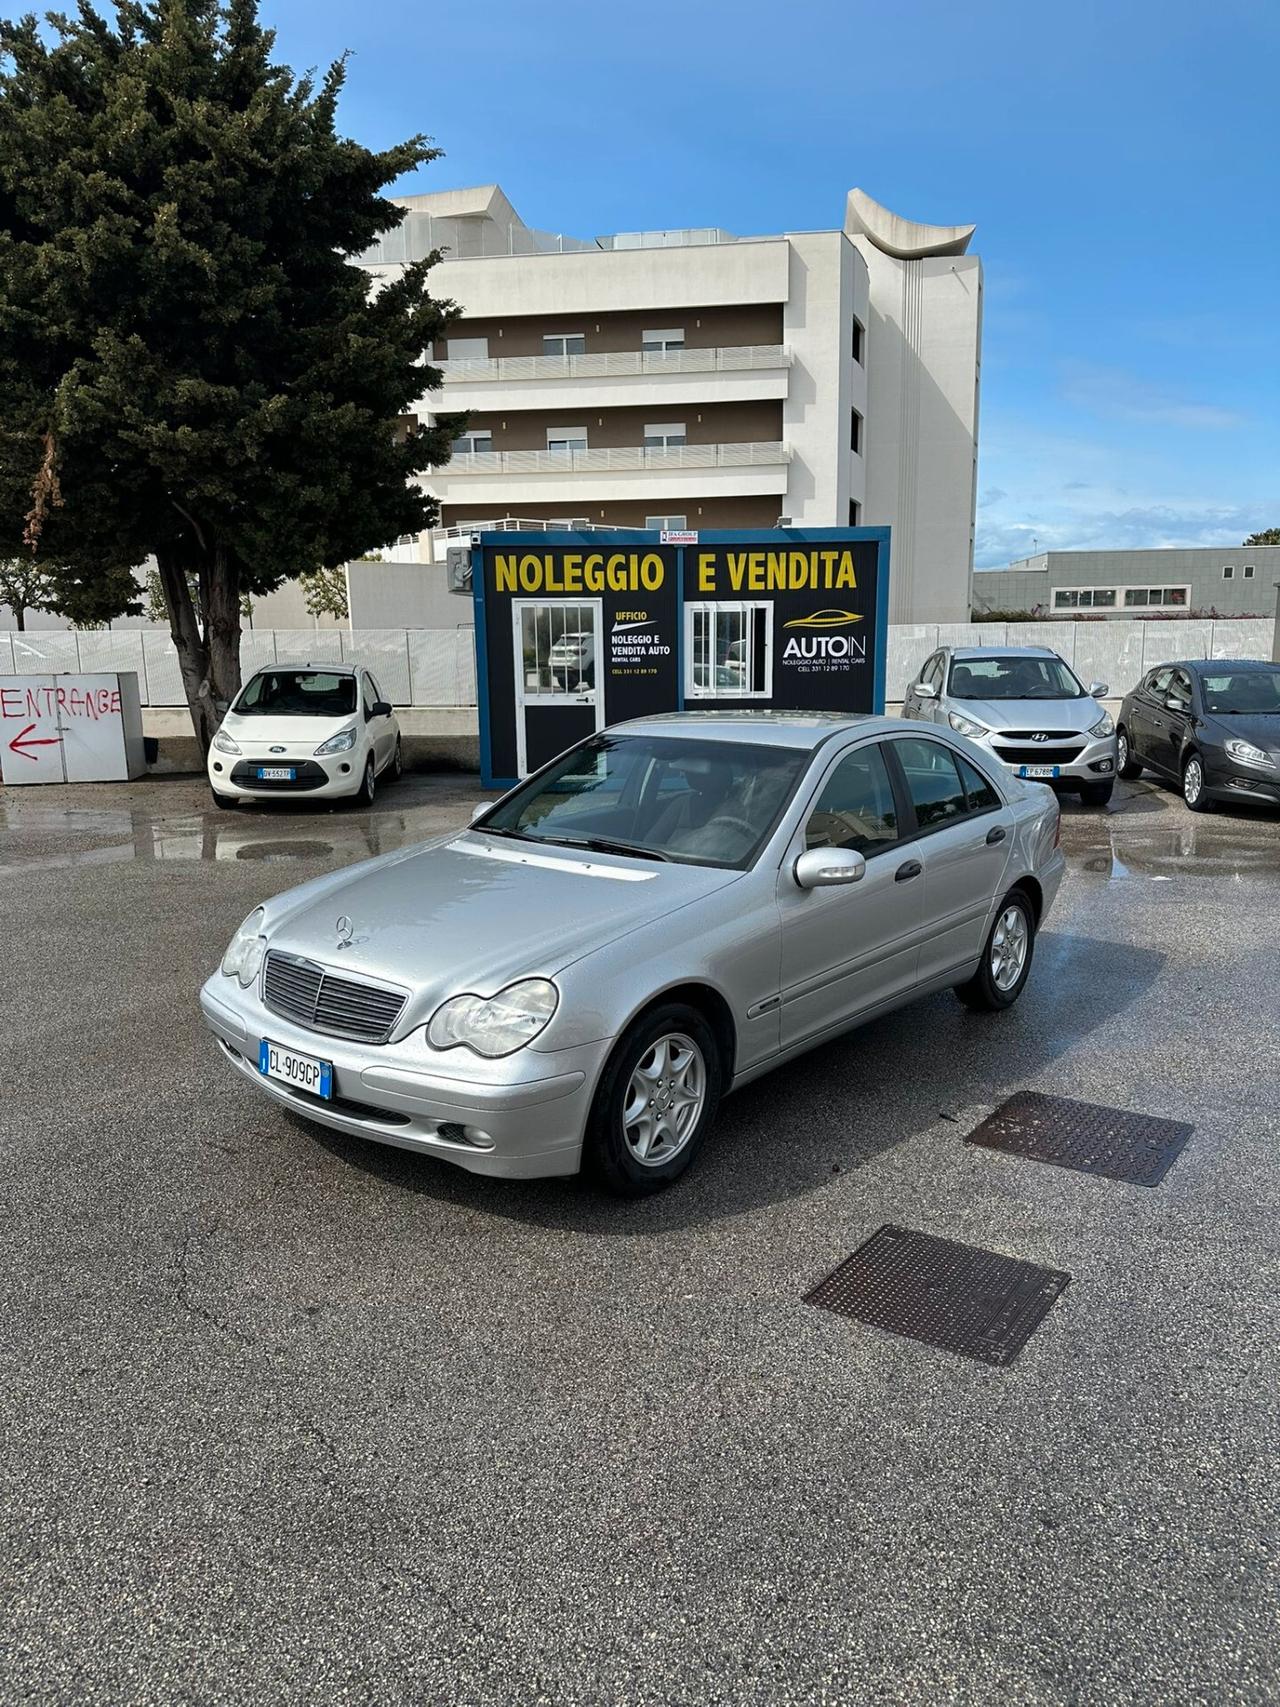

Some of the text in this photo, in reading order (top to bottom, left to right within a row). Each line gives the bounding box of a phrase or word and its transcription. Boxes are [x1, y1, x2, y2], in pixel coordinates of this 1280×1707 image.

[495, 551, 857, 592] NOLEGGIO E VENDITA
[616, 611, 647, 620] UFFICIO
[612, 635, 660, 644] NOLEGGIO E
[612, 646, 670, 655] VENDITA AUTO
[783, 635, 866, 658] AUTOIN
